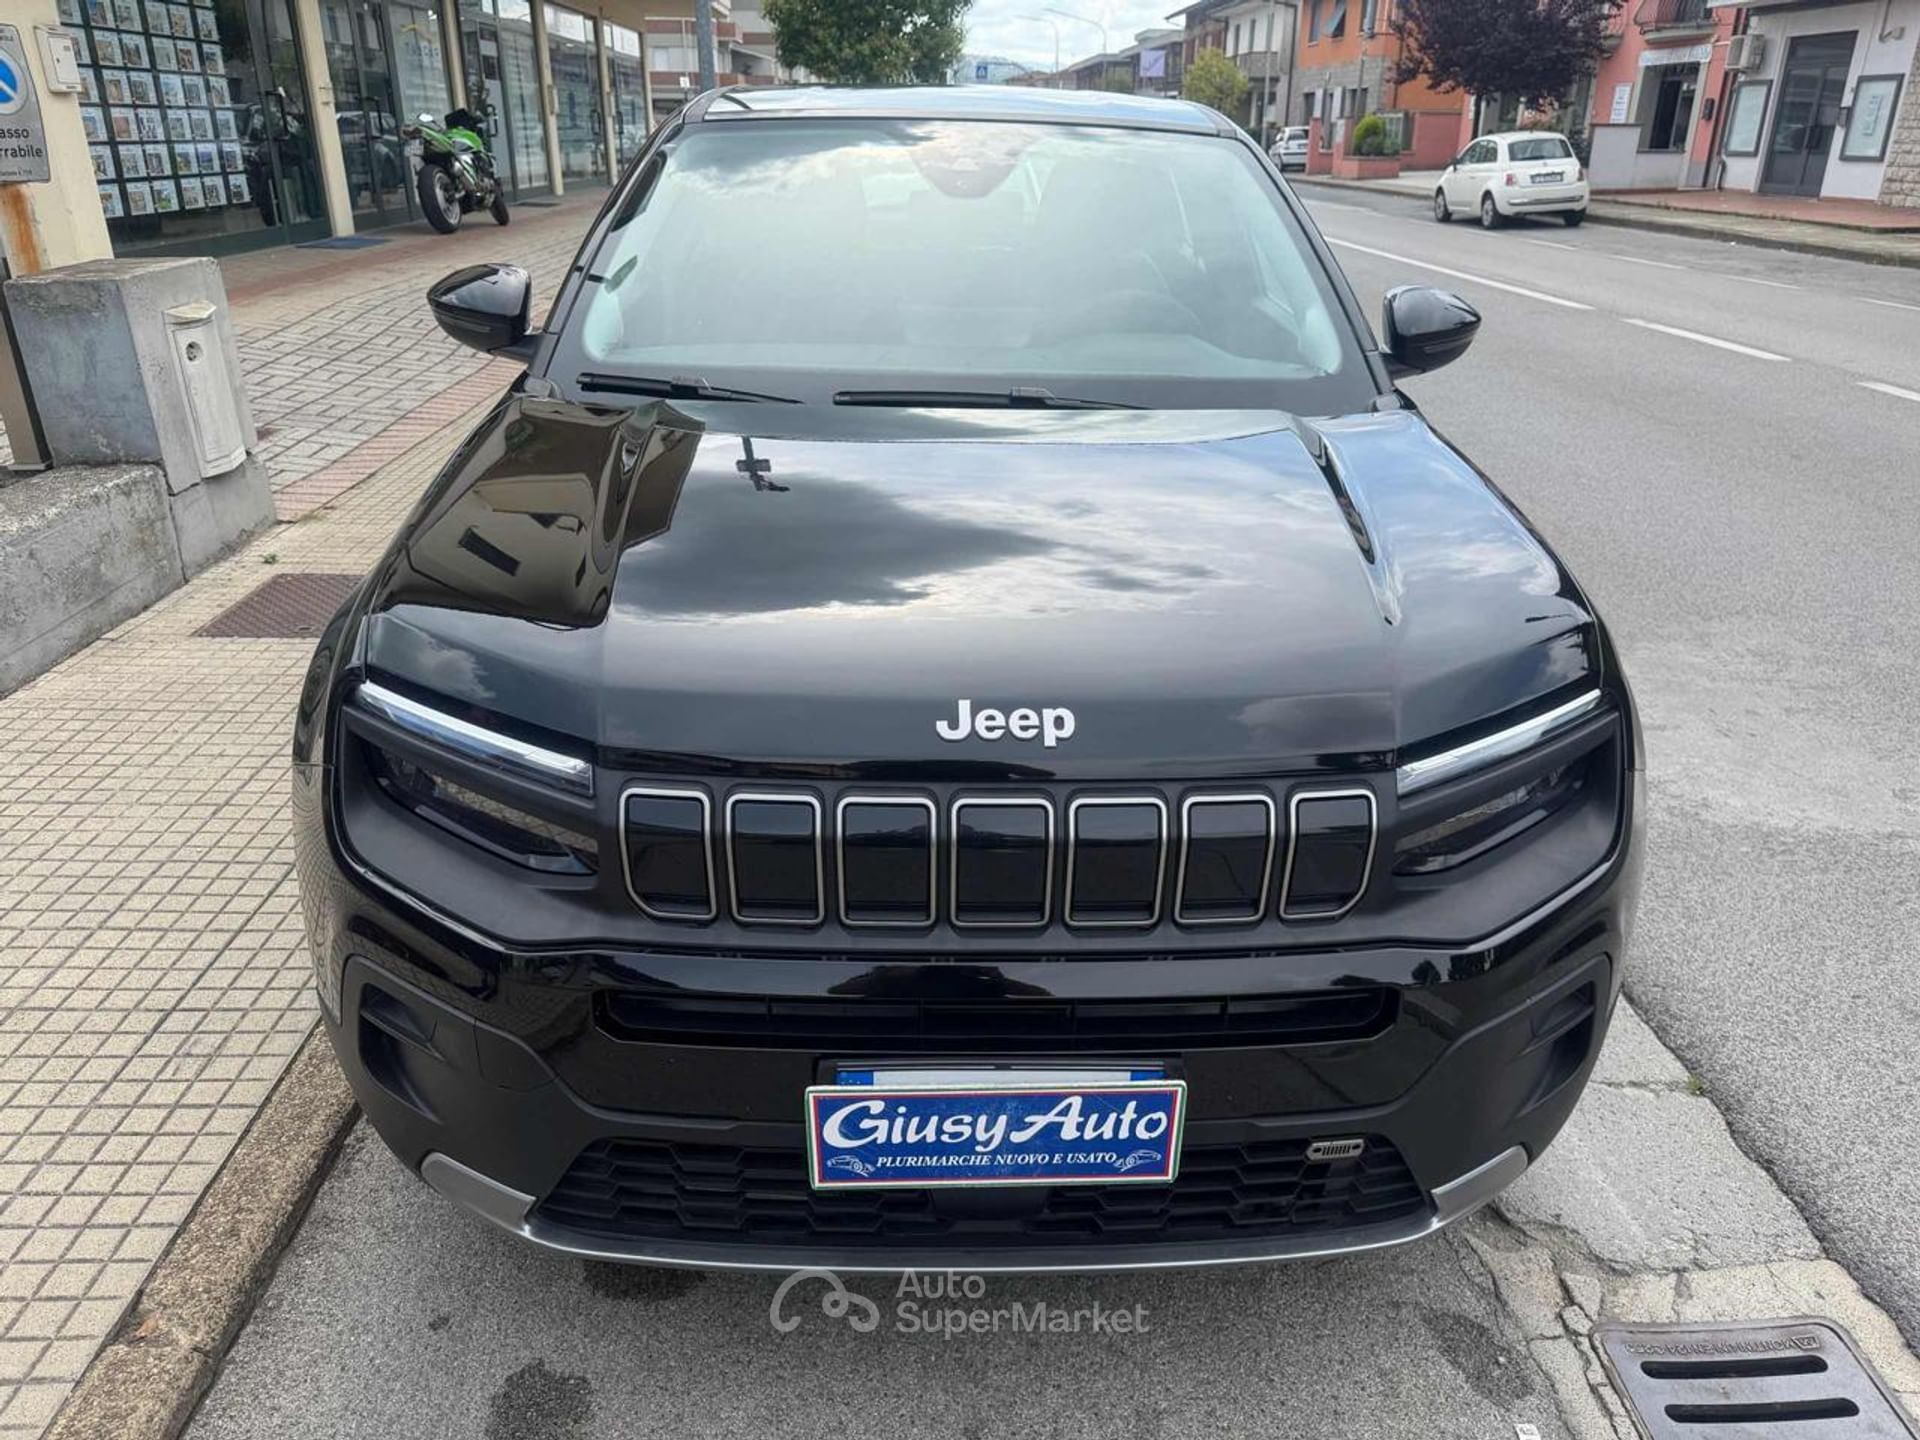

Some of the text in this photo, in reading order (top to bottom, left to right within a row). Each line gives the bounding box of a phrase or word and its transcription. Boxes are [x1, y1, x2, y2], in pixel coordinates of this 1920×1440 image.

[936, 699, 1076, 747] Jeep
[822, 1096, 1169, 1151] Giusy Auto
[876, 1152, 1116, 1168] PLURIMARCHE NUOVO E USATO
